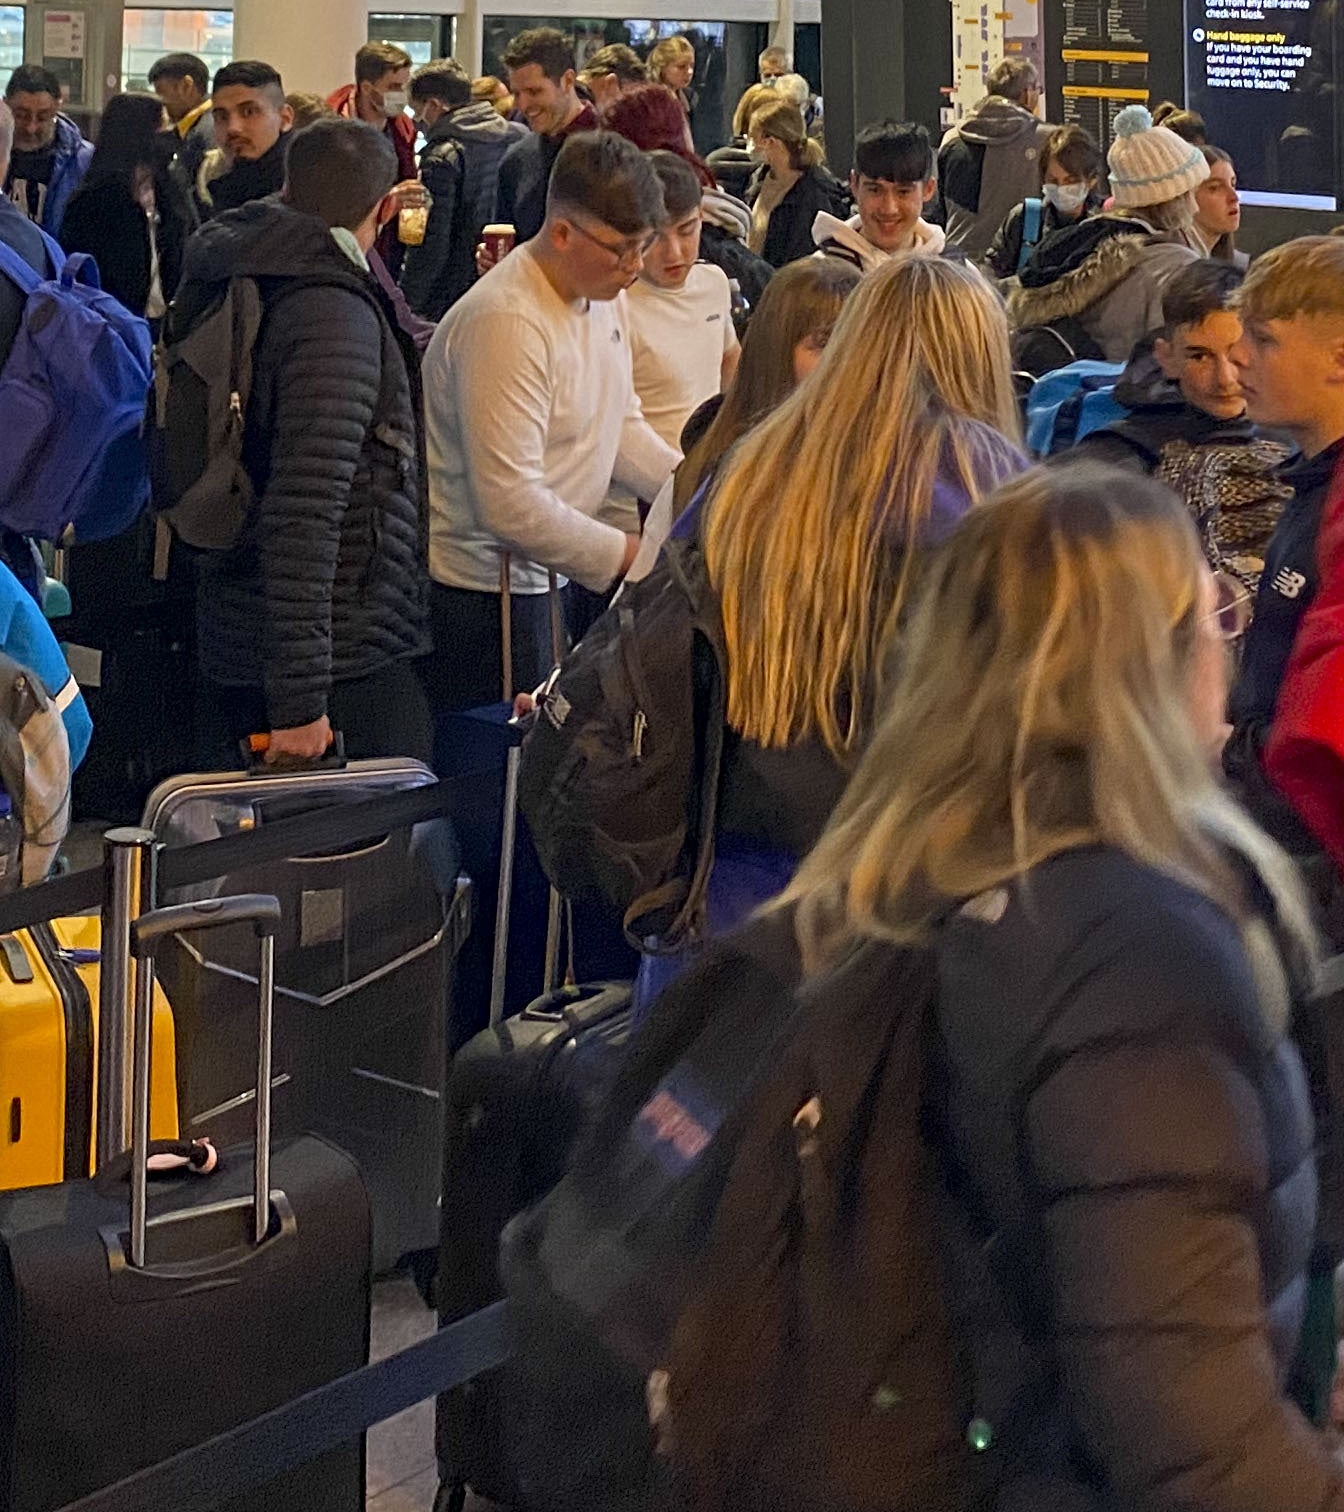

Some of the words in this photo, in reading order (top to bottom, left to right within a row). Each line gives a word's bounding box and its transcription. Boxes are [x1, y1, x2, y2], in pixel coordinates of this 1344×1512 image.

[1246, 0, 1261, 9] any
[1206, 9, 1239, 19] check-in
[1240, 9, 1265, 19] kiosk.
[1207, 31, 1228, 40] Hand
[1230, 31, 1265, 43] baggage
[1266, 33, 1286, 44] only
[1207, 42, 1213, 51] If
[1214, 44, 1229, 54] you
[1230, 43, 1251, 54] have
[1252, 45, 1272, 55] your
[1272, 44, 1312, 57] boarding
[1207, 54, 1225, 64] card
[1226, 55, 1242, 65] and
[1243, 57, 1260, 66] you
[1260, 56, 1281, 66] have
[1282, 56, 1304, 67] hand
[1207, 65, 1240, 77] luggage
[1241, 67, 1262, 78] only,
[1263, 69, 1279, 79] you
[1281, 69, 1296, 78] can
[1207, 78, 1230, 87] move
[1231, 79, 1242, 88] on
[1243, 78, 1253, 88] to
[1254, 79, 1291, 92] Security.
